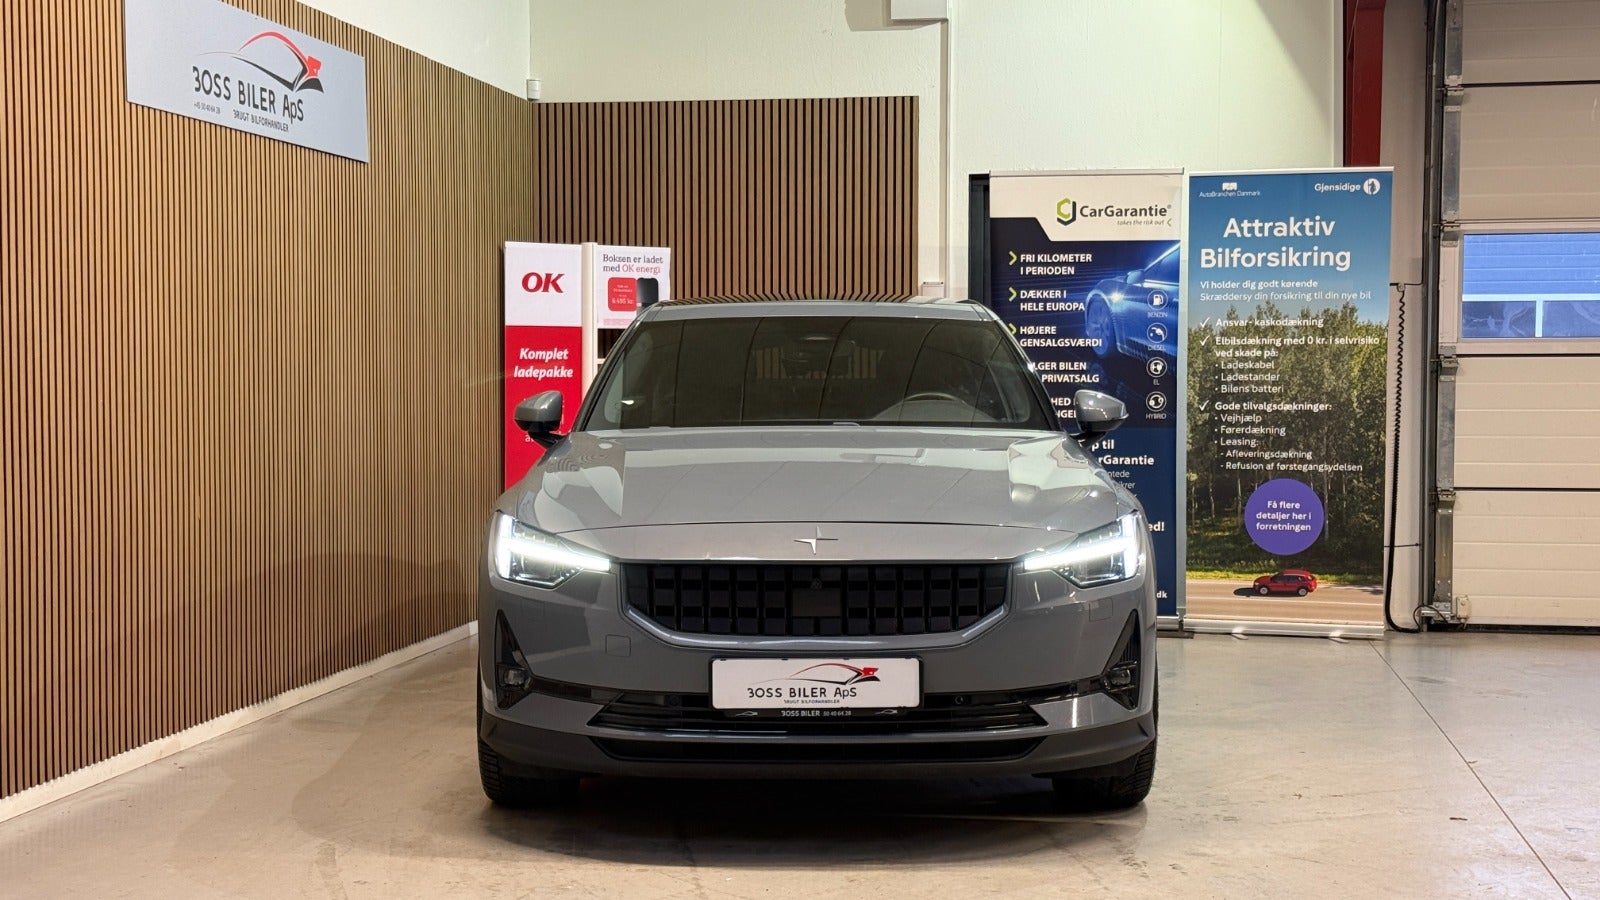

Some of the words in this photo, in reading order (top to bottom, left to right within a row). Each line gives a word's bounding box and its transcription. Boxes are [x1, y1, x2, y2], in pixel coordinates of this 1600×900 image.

[238, 80, 276, 114] BILER
[282, 94, 304, 124] ApS
[251, 115, 289, 132] BILFORHANDLER
[1314, 182, 1361, 193] Gjensidige
[1223, 215, 1336, 238] Attraktiv
[603, 254, 631, 263] Boksen
[1020, 254, 1035, 263] FRI
[1038, 254, 1092, 263] KILOMETER
[1200, 246, 1351, 271] Bilforsikring
[622, 264, 635, 272] OK
[636, 266, 660, 275] energi
[1020, 267, 1024, 275] I
[1025, 266, 1075, 275] PERIODEN
[521, 272, 564, 294] OK
[1242, 280, 1256, 290] dig
[1258, 280, 1279, 290] godt
[1281, 280, 1318, 288] kørende
[1020, 290, 1061, 299] DÆKKER
[1063, 290, 1067, 298] I
[1200, 292, 1252, 302] Skræddersy
[1254, 292, 1268, 300] din
[1270, 291, 1312, 301] forsikring
[1314, 291, 1323, 299] til
[1325, 291, 1339, 299] din
[1341, 292, 1357, 301] nye
[1360, 291, 1371, 299] bil
[1020, 302, 1044, 311] HELE
[1047, 302, 1085, 311] EUROPA
[1254, 317, 1324, 328] kaskodækning
[1019, 325, 1057, 335] HØJERE
[1019, 338, 1102, 348] GENSALGSVÆRDI
[1216, 336, 1282, 347] Elbilsdækning
[1284, 336, 1305, 345] med
[1307, 336, 1314, 345] 0
[1316, 336, 1328, 345] kr.
[1334, 335, 1380, 345] selvrisiko
[519, 347, 568, 363] Komplet
[1215, 349, 1233, 357] ved
[1234, 348, 1262, 357] skade
[1264, 348, 1279, 359] på:
[1033, 362, 1057, 371] LGER
[1059, 362, 1087, 370] BILEN
[1221, 360, 1274, 369] Ladeskabel
[514, 366, 574, 381] ladepakke
[1041, 374, 1100, 383] PRIVATSALG
[1221, 373, 1280, 382] Ladestander
[1221, 385, 1250, 393] Bilens
[1252, 384, 1284, 393] batteri
[1214, 402, 1240, 410] Gode
[1243, 401, 1332, 413] tilvalgsdækninger:
[1220, 414, 1262, 424] Vejhjælp
[1220, 426, 1286, 436] Førerdækning
[1102, 439, 1115, 450] til
[1098, 455, 1154, 465] rGarantie
[1226, 450, 1312, 460] Afleveringsdækning
[1226, 462, 1264, 470] Refusion
[1266, 462, 1275, 470] af
[1276, 462, 1363, 472] førstegangsydelsen
[1267, 500, 1278, 508] Få
[1280, 500, 1300, 508] flere
[1256, 512, 1290, 521] detaljer
[1256, 523, 1311, 532] forretningen
[790, 687, 826, 698] BILER
[834, 687, 857, 699] ApS
